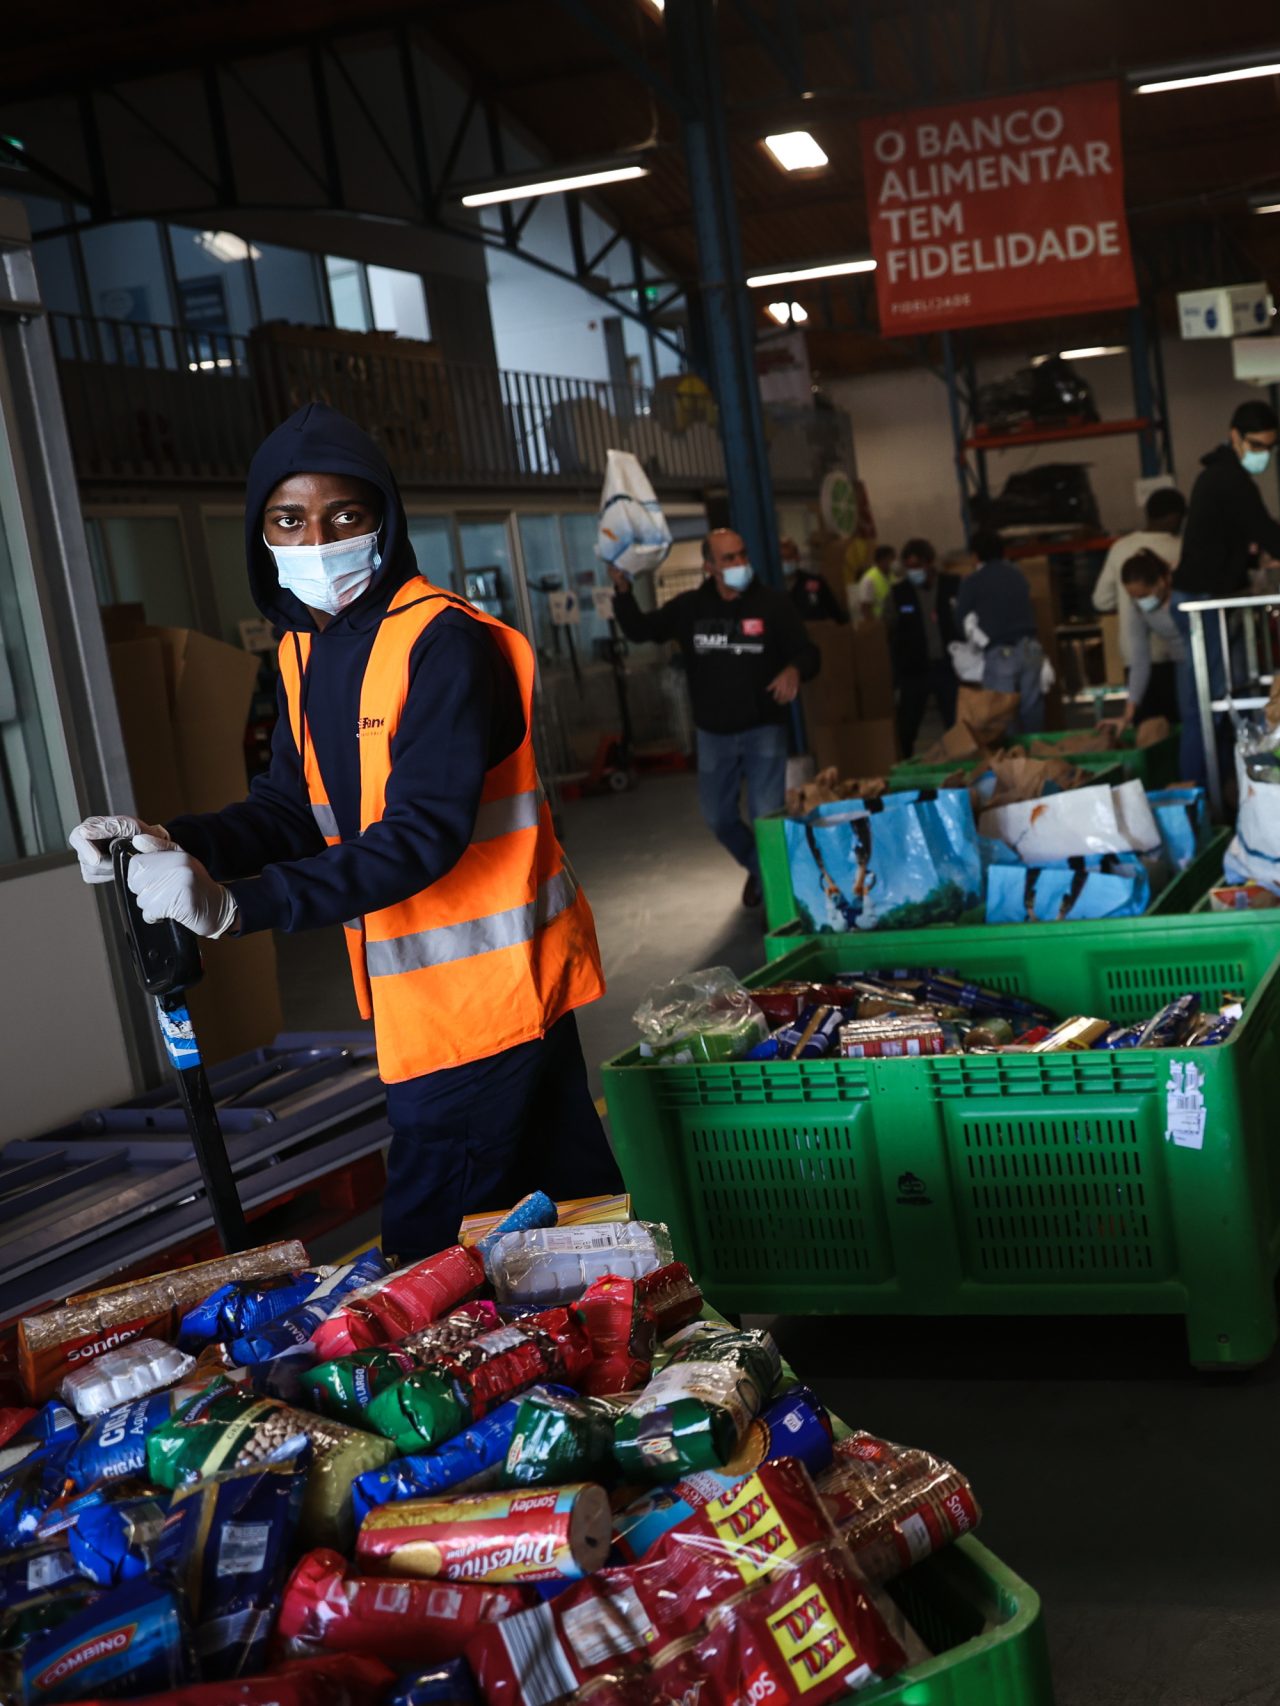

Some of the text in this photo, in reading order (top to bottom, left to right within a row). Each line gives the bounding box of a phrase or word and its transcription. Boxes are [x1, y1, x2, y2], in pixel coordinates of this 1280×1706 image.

[873, 105, 1064, 164] O BANCO
[878, 140, 1113, 206] ALIMENTAR
[878, 200, 965, 244] TEM
[886, 220, 1121, 285] FIDELIDADE
[67, 1327, 144, 1362] sondey
[282, 1319, 306, 1345] IGALA
[357, 1367, 370, 1398] LARGO
[99, 1401, 134, 1448] CIGA
[102, 1455, 145, 1478] CIGAL
[510, 1495, 557, 1512] Sondey
[946, 1494, 971, 1531] Sonde
[448, 1531, 558, 1580] Digestive
[771, 1593, 827, 1644] XXL
[43, 1633, 128, 1686] COMBINO
[788, 1628, 846, 1679] XXL
